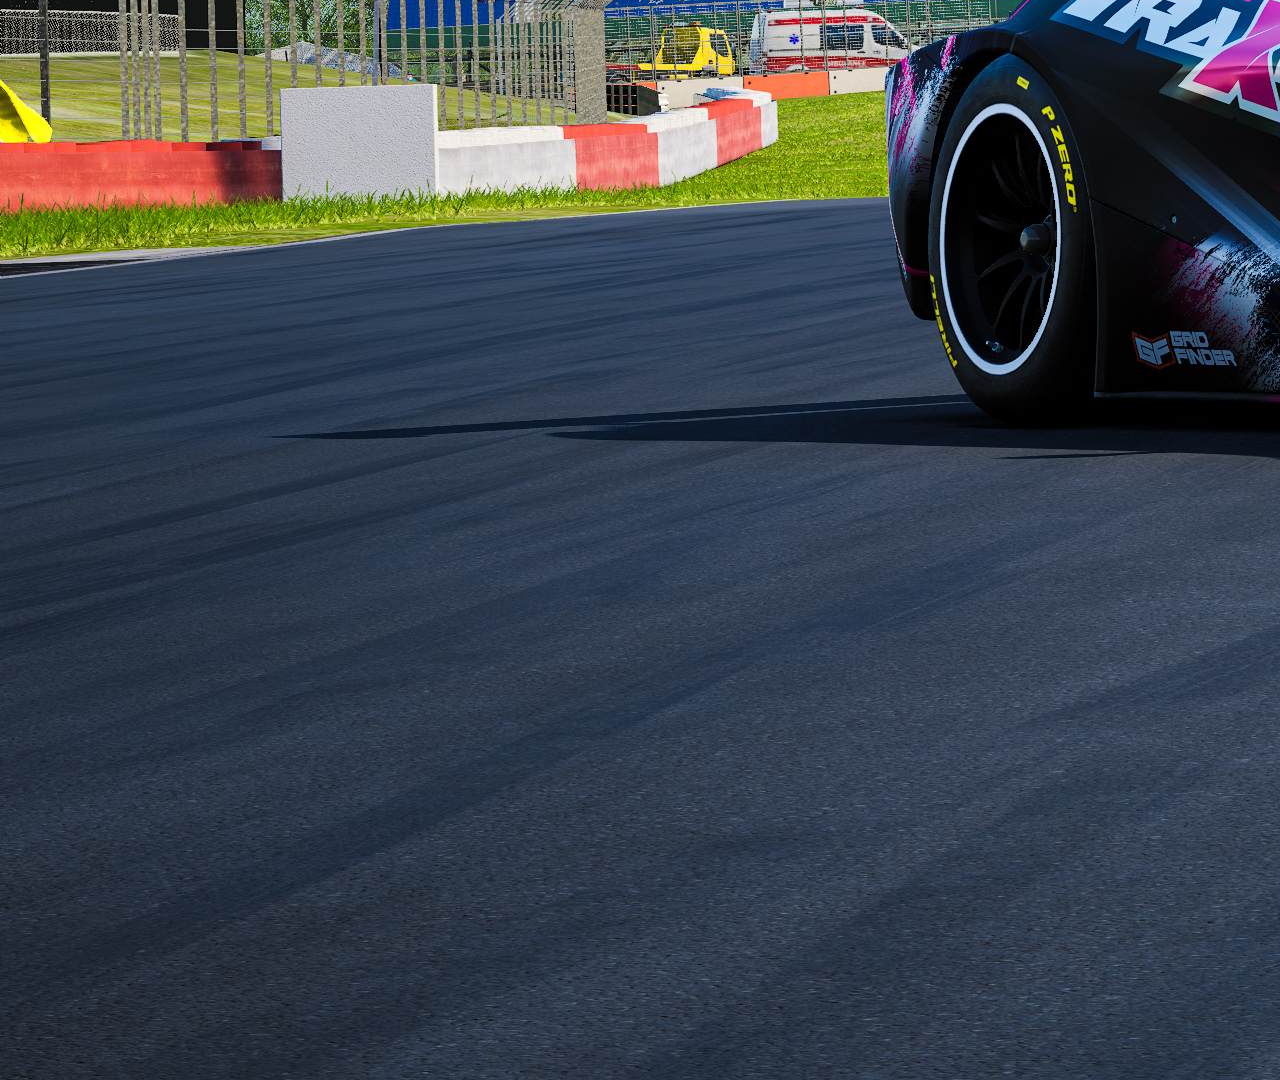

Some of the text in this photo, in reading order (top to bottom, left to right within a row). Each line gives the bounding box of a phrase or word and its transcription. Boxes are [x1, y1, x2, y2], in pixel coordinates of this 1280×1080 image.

[1050, 125, 1077, 206] ZERO
[1169, 330, 1209, 348] GRID
[1174, 348, 1238, 366] FINDER
